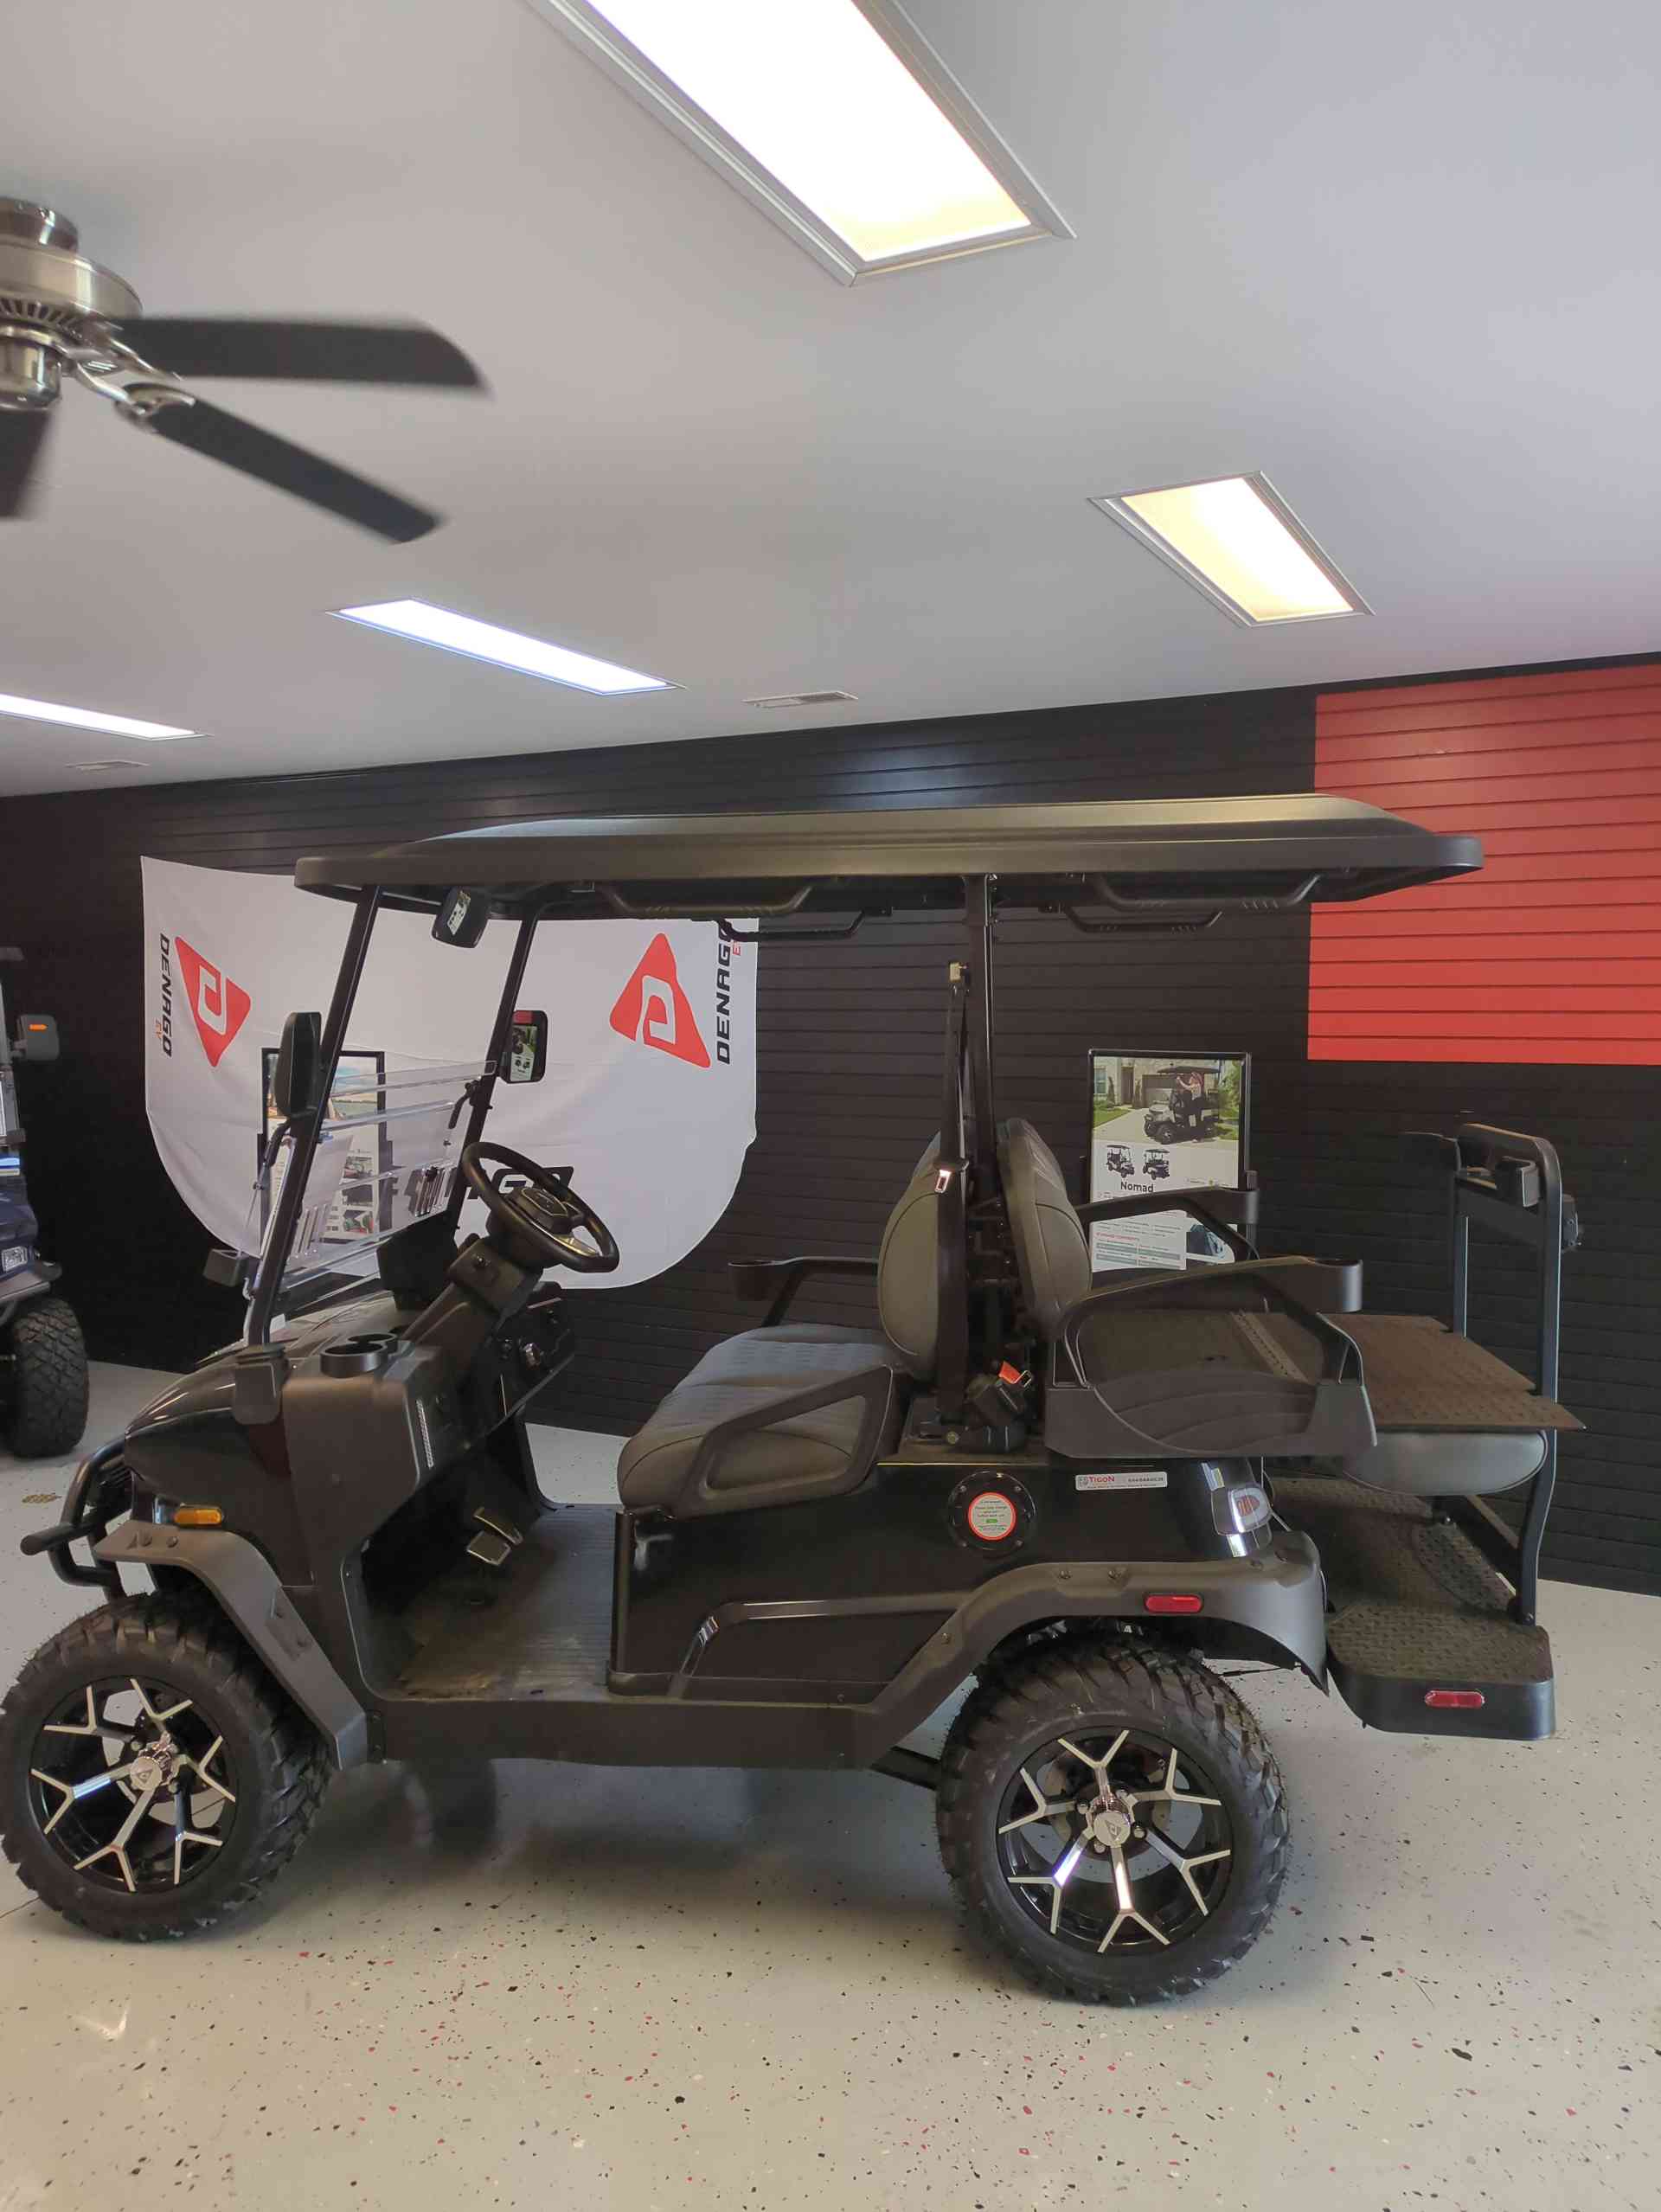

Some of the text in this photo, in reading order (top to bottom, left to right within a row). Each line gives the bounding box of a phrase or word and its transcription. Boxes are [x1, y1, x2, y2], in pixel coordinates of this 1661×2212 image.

[733, 940, 742, 956] E
[159, 933, 172, 1058] DENAGO
[1120, 1181, 1154, 1193] Nomad
